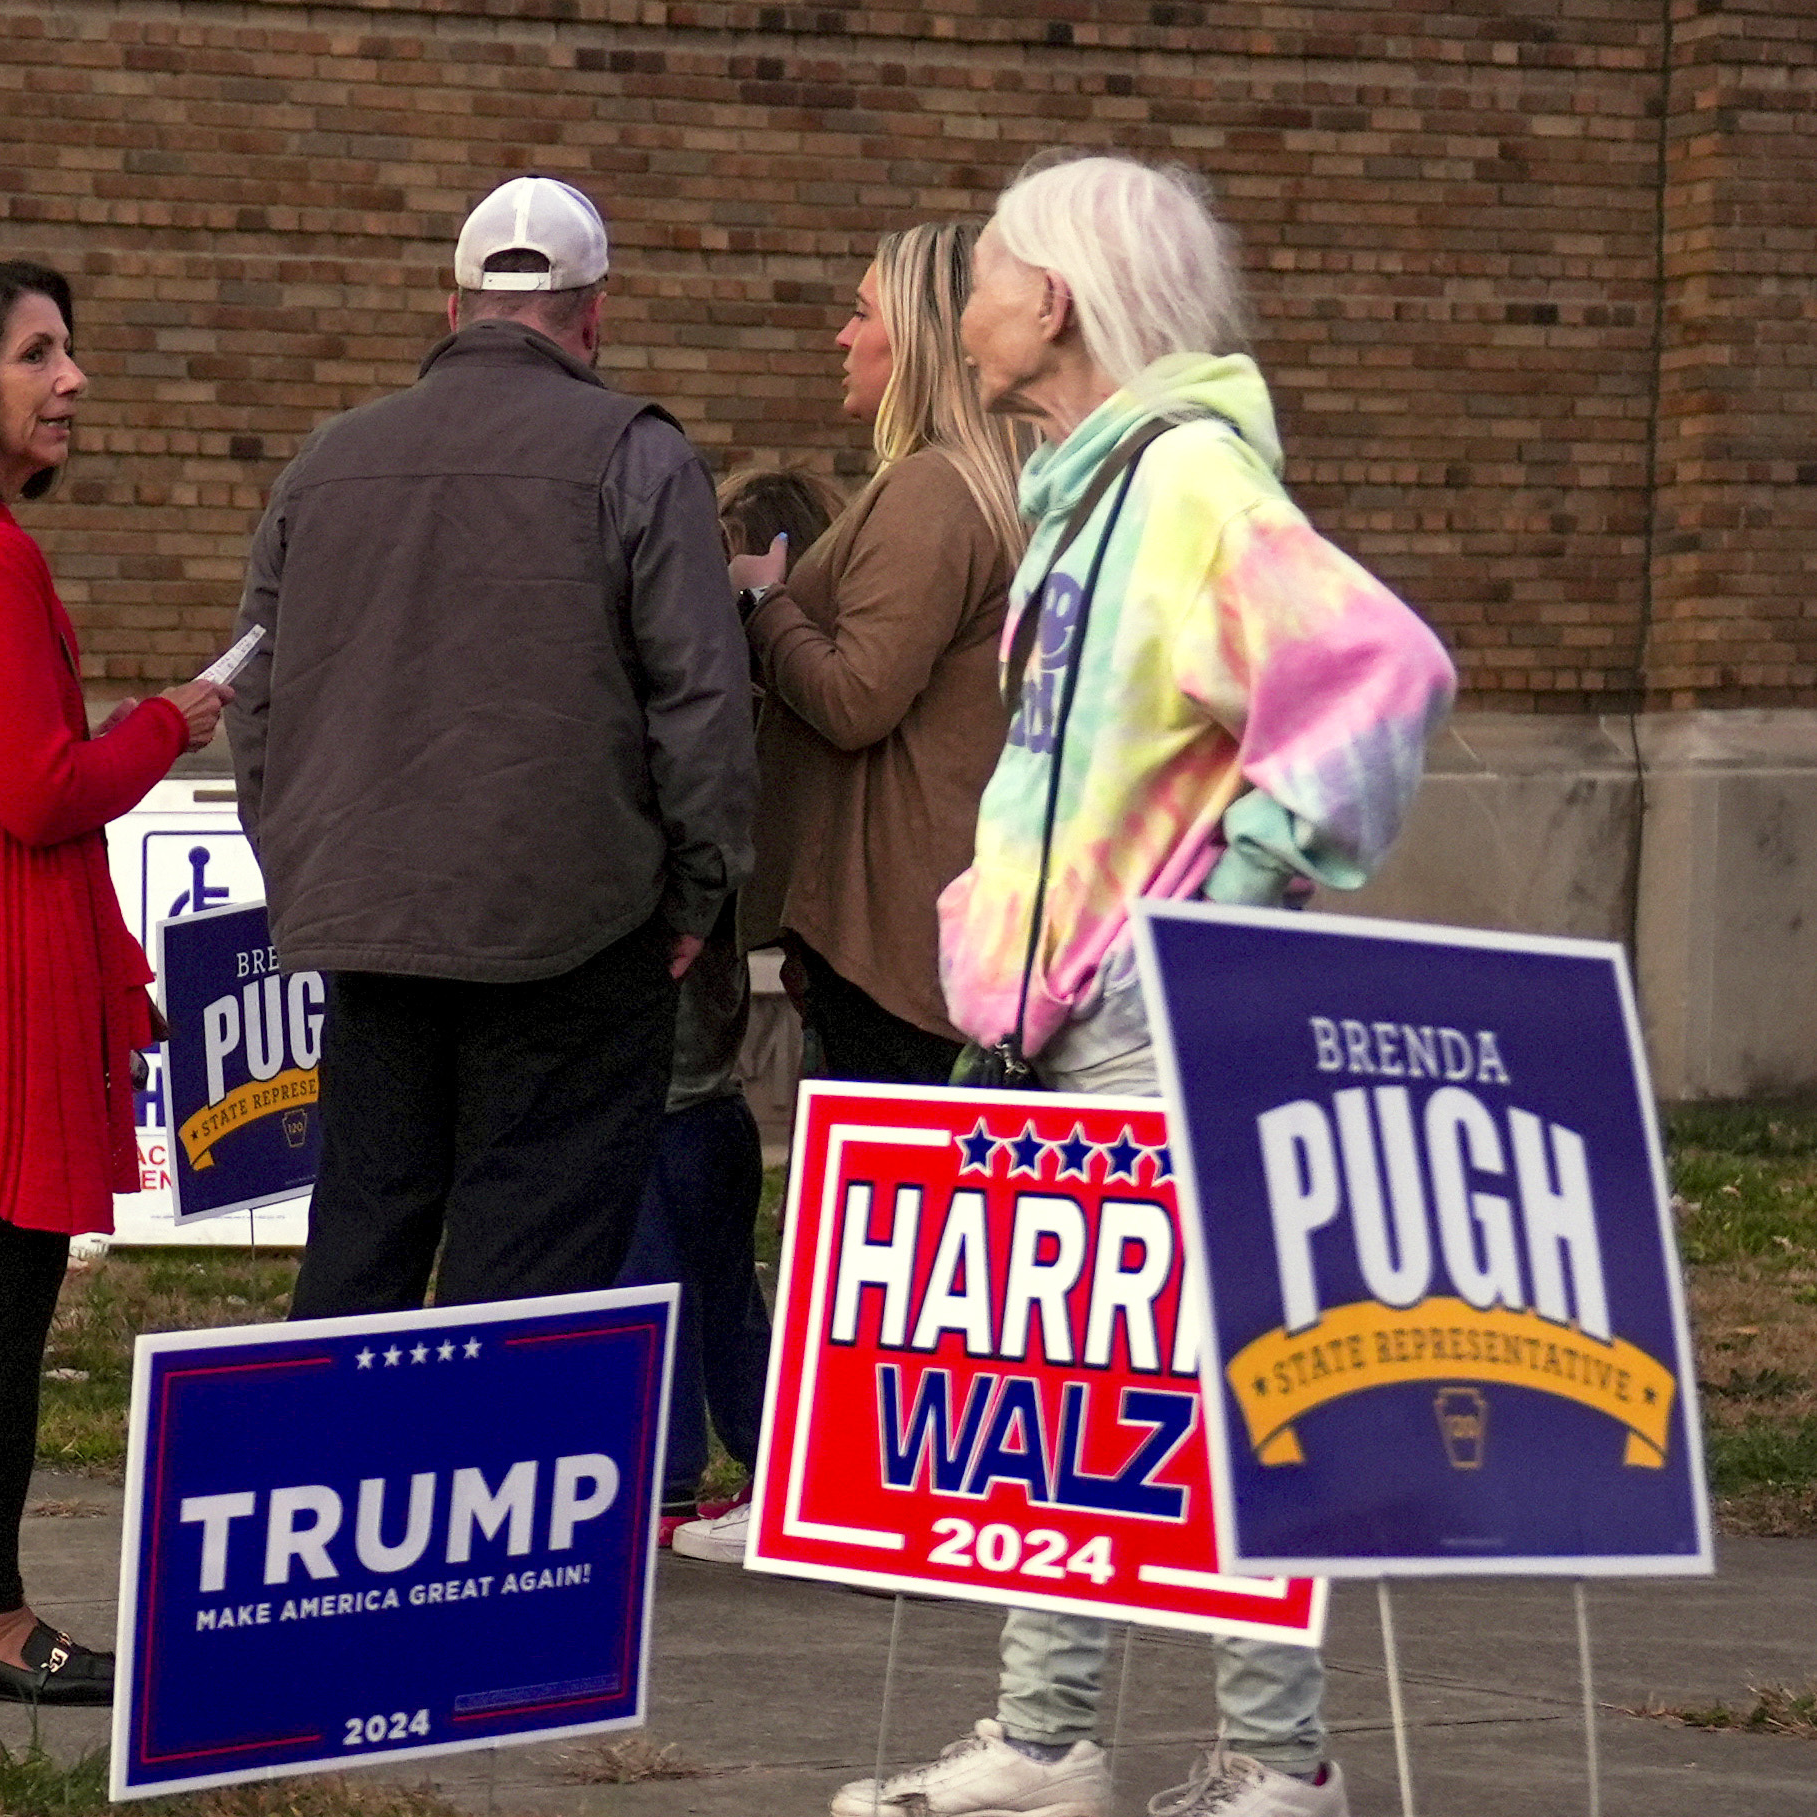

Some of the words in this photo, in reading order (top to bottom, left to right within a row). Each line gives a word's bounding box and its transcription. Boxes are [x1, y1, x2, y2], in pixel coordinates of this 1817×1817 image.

[236, 946, 279, 978] BRE
[203, 971, 325, 1108] PUG
[1309, 1016, 1511, 1084] BRENDA
[201, 1100, 248, 1137] STATE
[252, 1078, 317, 1109] REPRESE
[286, 1121, 304, 1134] 120
[1256, 1085, 1612, 1344] PUGH
[828, 1180, 1200, 1378] HARR
[1272, 1335, 1366, 1395] STATE
[1374, 1327, 1634, 1402] REPRESENTATIVE
[875, 1362, 1199, 1524] WALZ
[179, 1453, 620, 1593] TRUMP
[927, 1517, 1115, 1584] 2024
[196, 1602, 271, 1631] MAKE
[279, 1588, 400, 1623] AMERICA
[408, 1576, 494, 1607] GREAT
[500, 1563, 592, 1595] AGAIN!
[342, 1708, 431, 1746] 2024
